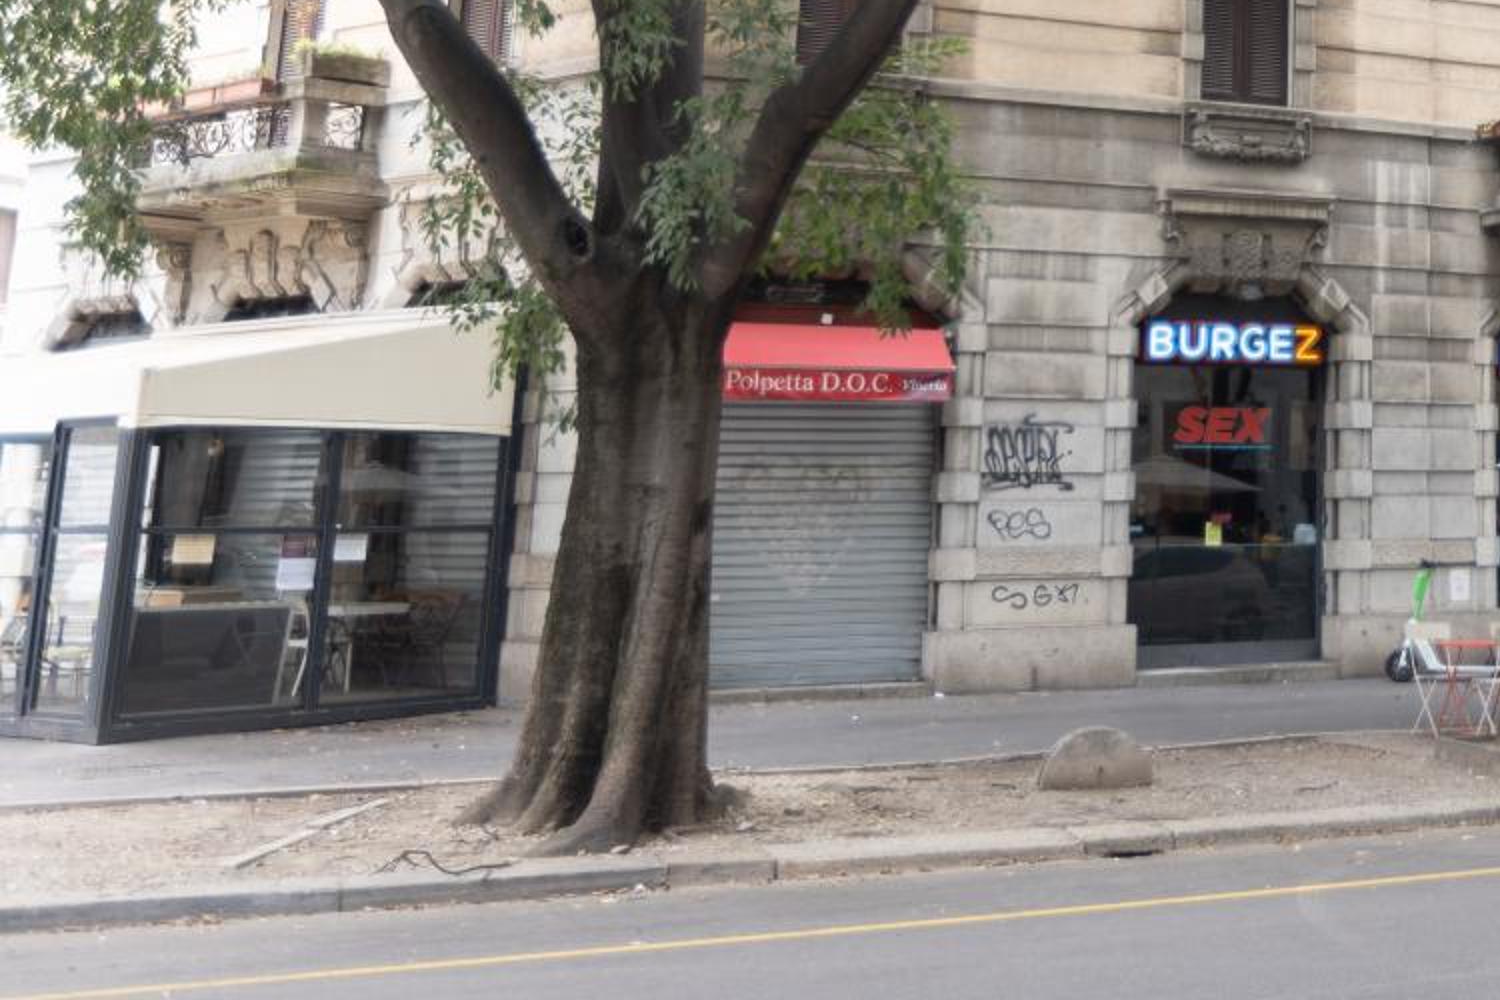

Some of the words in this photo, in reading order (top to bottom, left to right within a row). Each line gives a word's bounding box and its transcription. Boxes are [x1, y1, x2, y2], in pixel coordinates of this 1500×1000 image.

[1148, 323, 1322, 361] BURGEZ
[725, 369, 813, 396] Polpetta
[820, 371, 894, 394] D.O.C.
[1173, 406, 1272, 443] SEX
